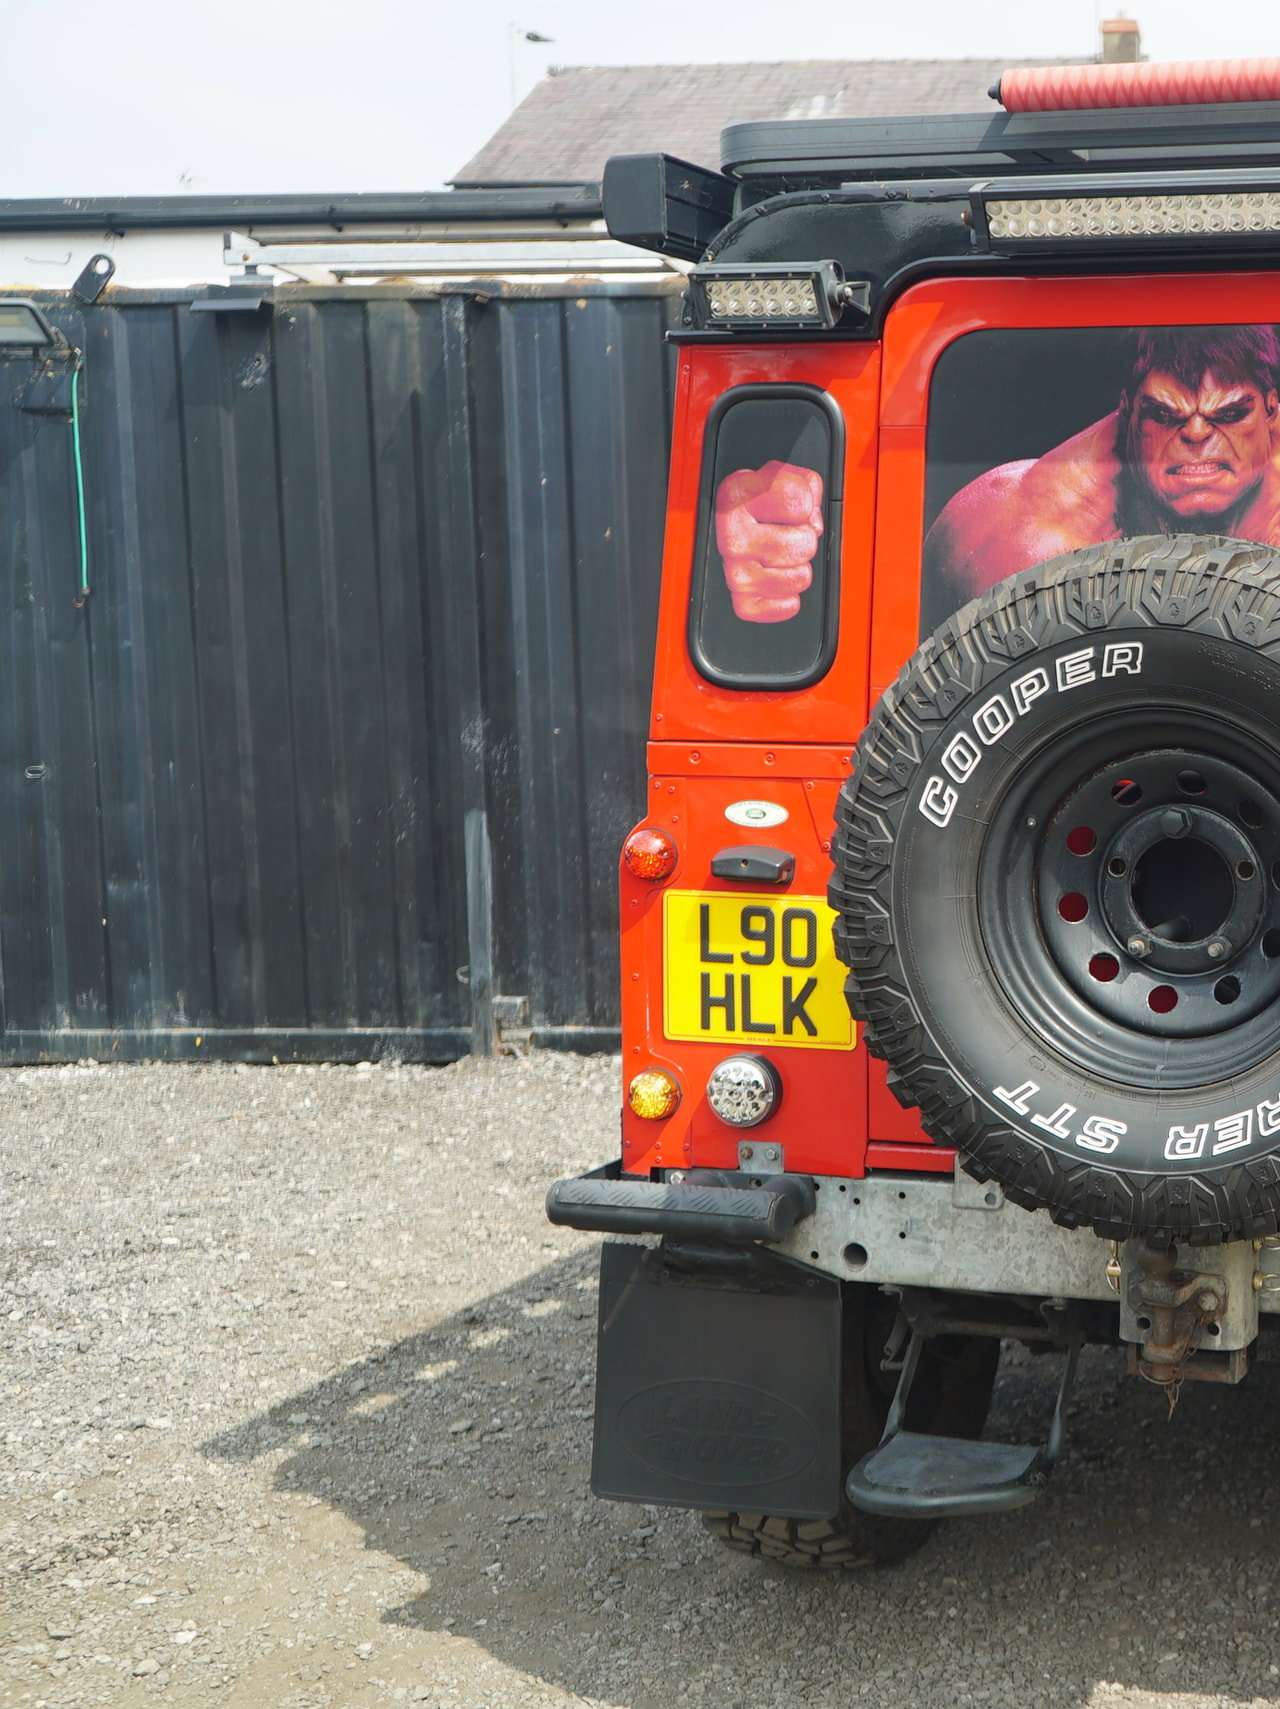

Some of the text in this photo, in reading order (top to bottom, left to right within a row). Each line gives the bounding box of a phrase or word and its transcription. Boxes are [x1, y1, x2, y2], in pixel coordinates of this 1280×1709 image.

[919, 641, 1144, 828] COOPER
[699, 903, 818, 969] L90
[700, 971, 818, 1037] HLK
[991, 1080, 1128, 1154] STT
